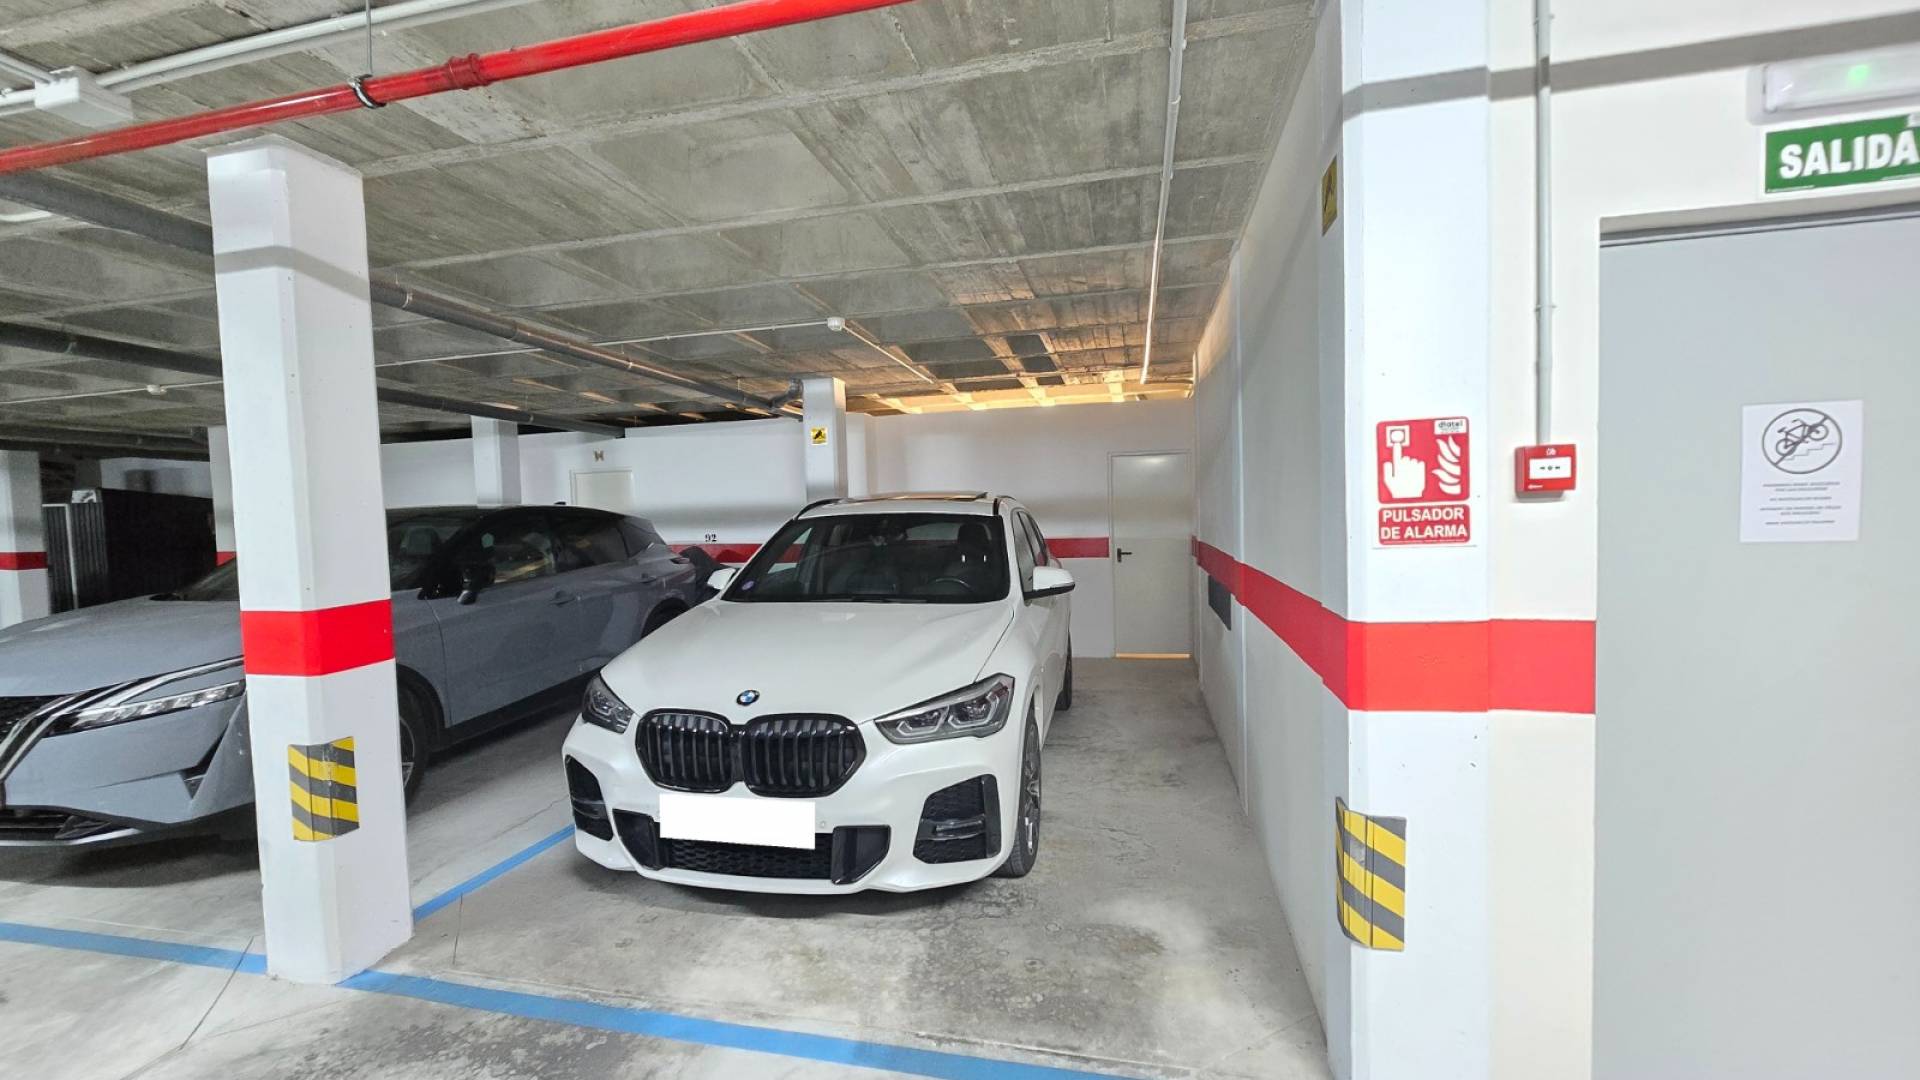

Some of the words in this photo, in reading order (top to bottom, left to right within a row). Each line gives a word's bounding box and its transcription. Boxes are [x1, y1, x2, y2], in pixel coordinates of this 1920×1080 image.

[1780, 130, 1920, 179] SALIDA
[1383, 507, 1464, 522] PULSADOR
[705, 533, 717, 542] 92
[1381, 527, 1400, 539] DE
[1404, 524, 1467, 538] ALARMA
